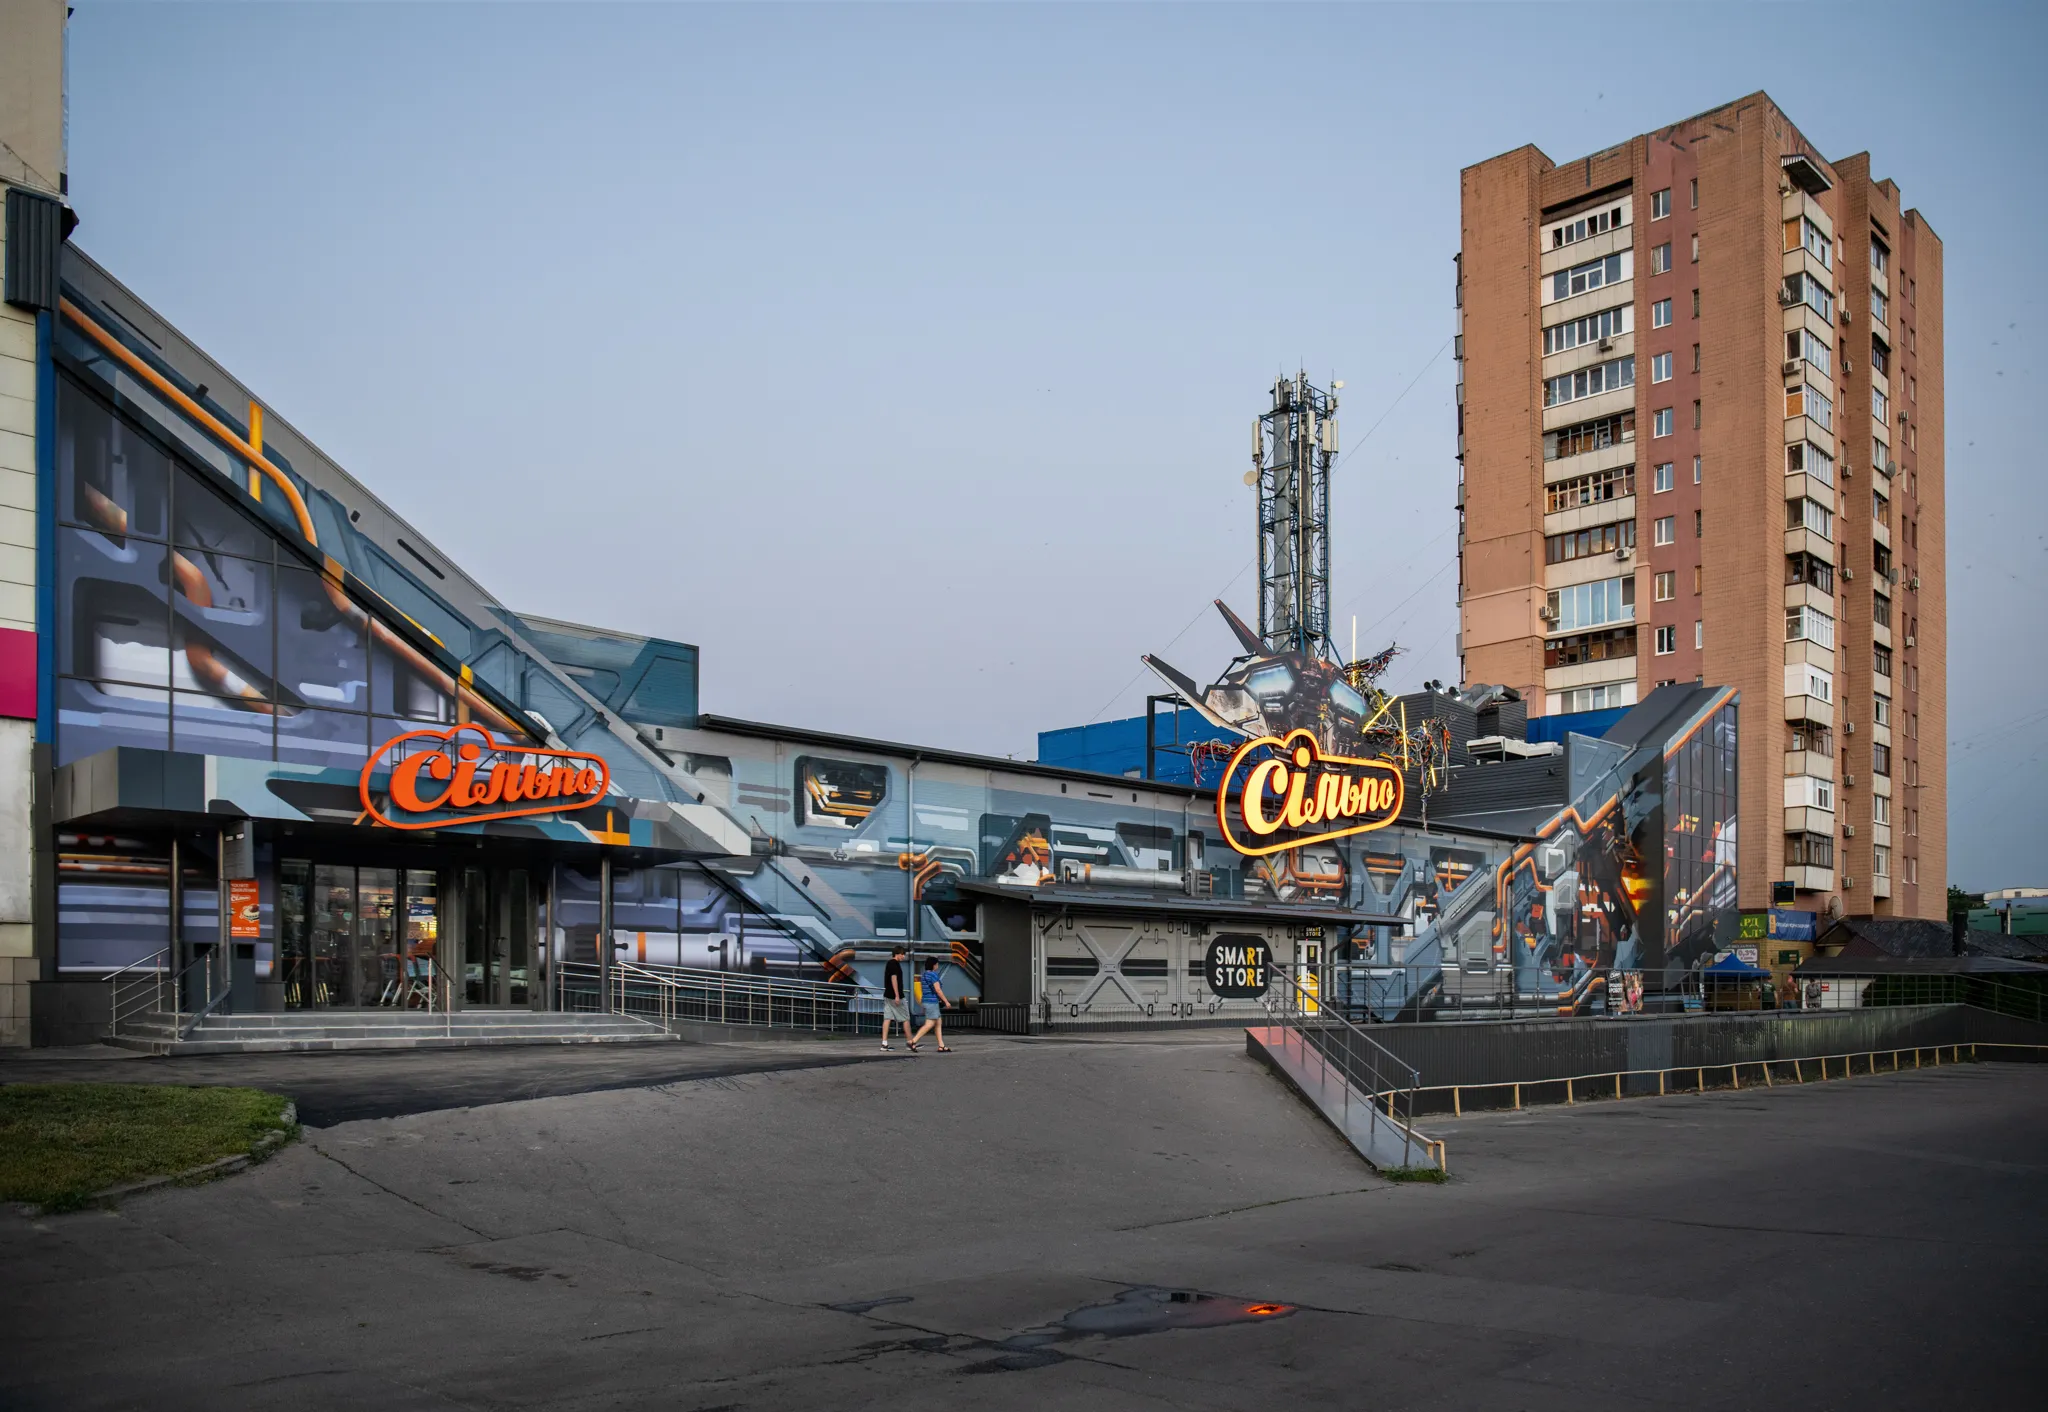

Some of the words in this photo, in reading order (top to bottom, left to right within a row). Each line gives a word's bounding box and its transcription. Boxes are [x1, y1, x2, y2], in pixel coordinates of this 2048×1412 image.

[390, 744, 597, 812] Сільпо
[1241, 747, 1395, 834] Сільпо
[1740, 918, 1759, 928] РД
[1215, 945, 1265, 966] SMART
[1215, 967, 1265, 987] STORE
